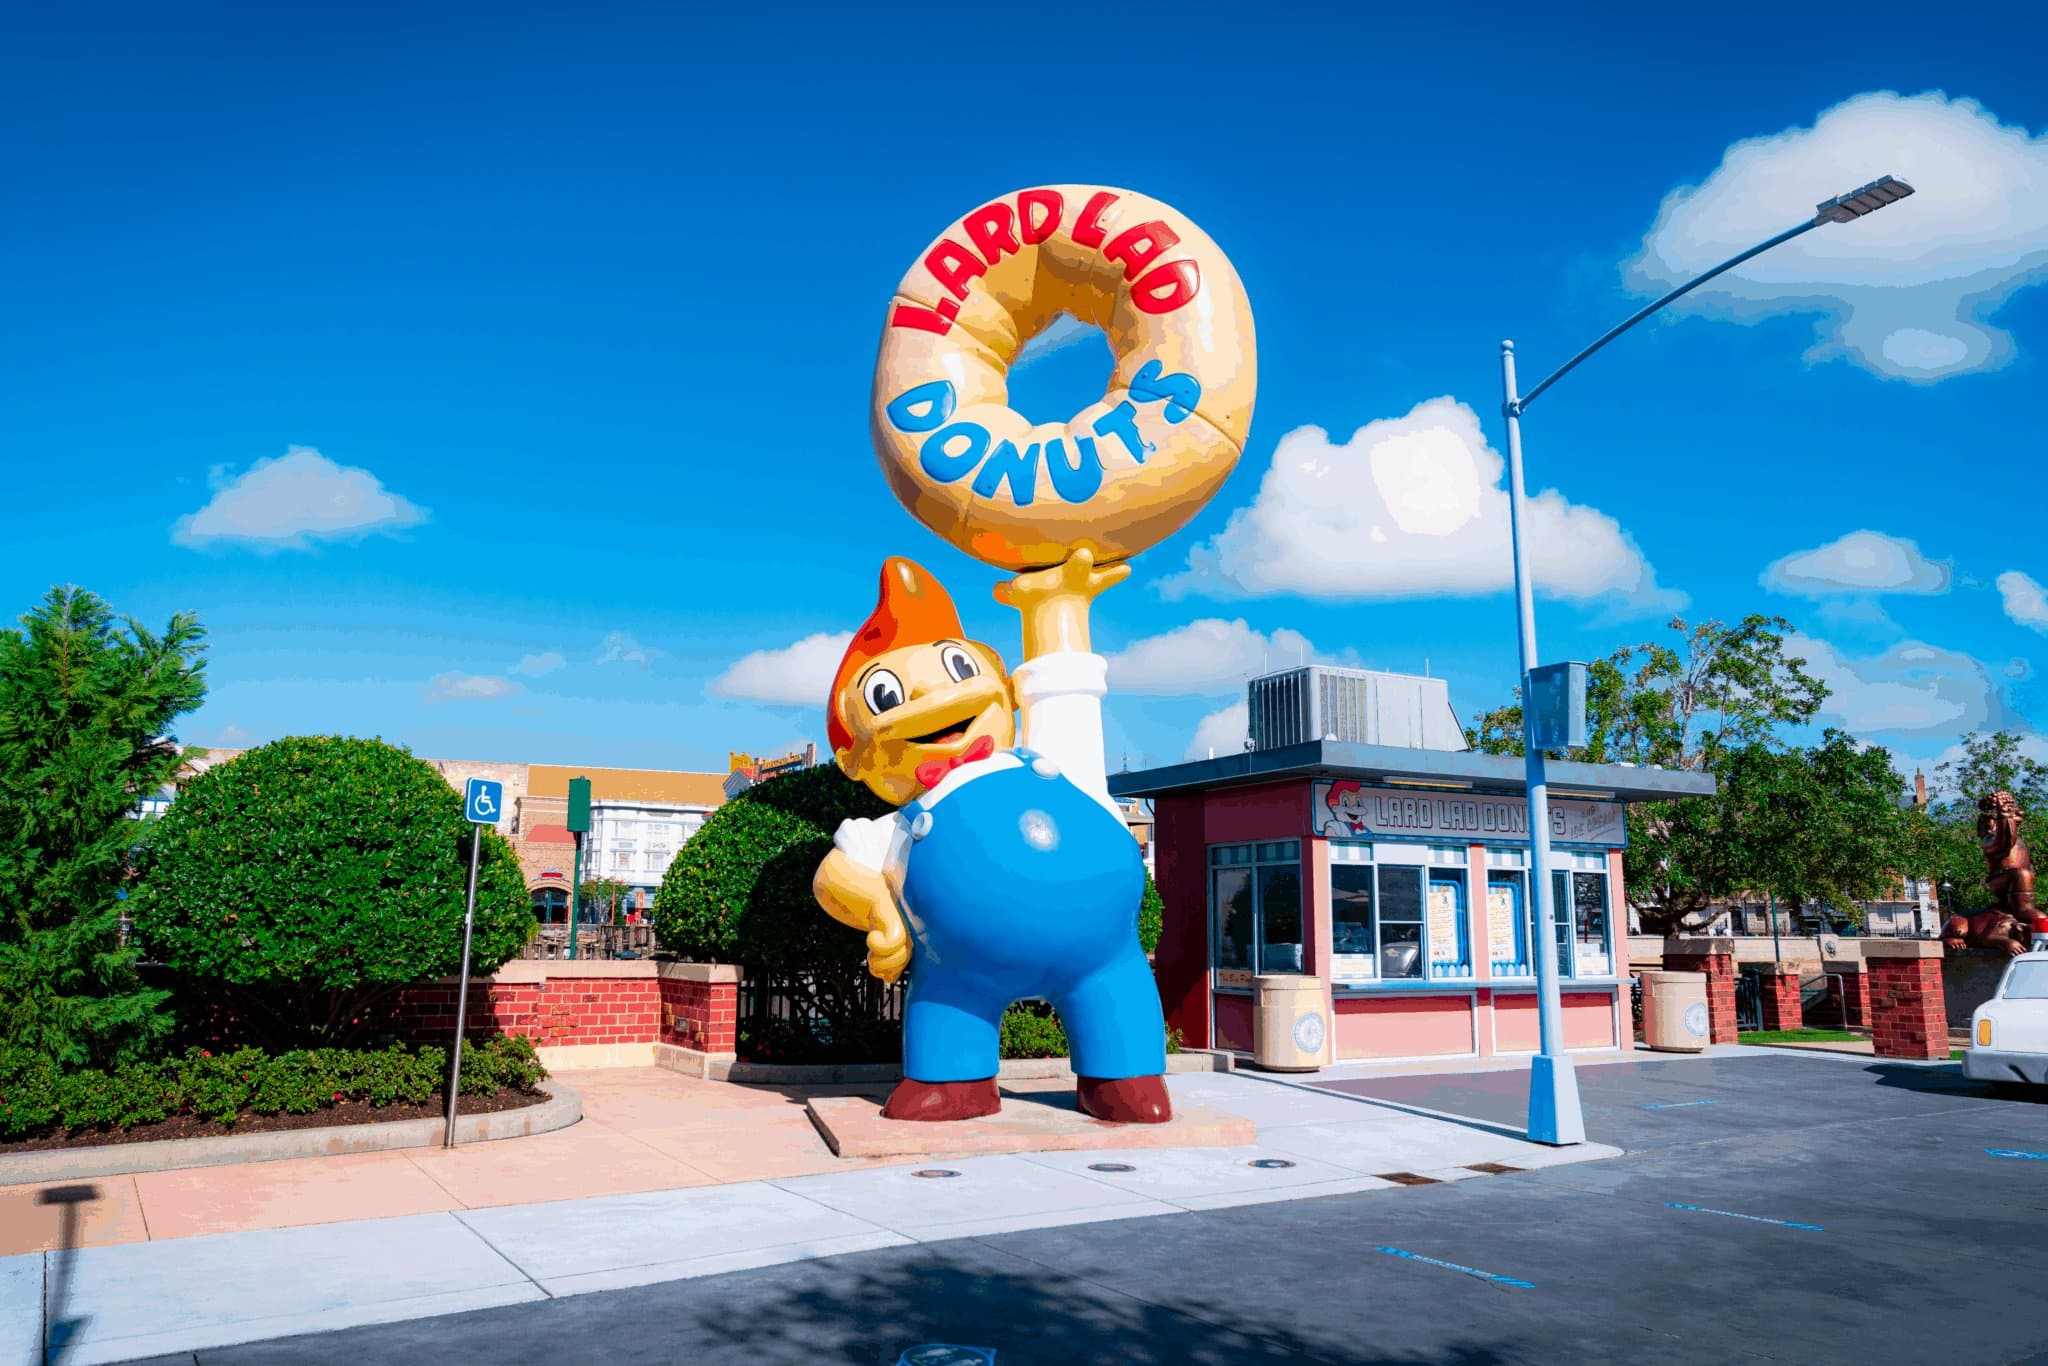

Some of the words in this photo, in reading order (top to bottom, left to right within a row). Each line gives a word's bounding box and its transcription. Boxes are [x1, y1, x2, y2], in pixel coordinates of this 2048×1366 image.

[892, 189, 1064, 336] LARD
[1070, 190, 1200, 314] LAD
[886, 359, 1202, 506] DONUTS
[1374, 796, 1434, 829] LARD
[1437, 800, 1479, 831] LAD
[1481, 802, 1567, 836] DONS
